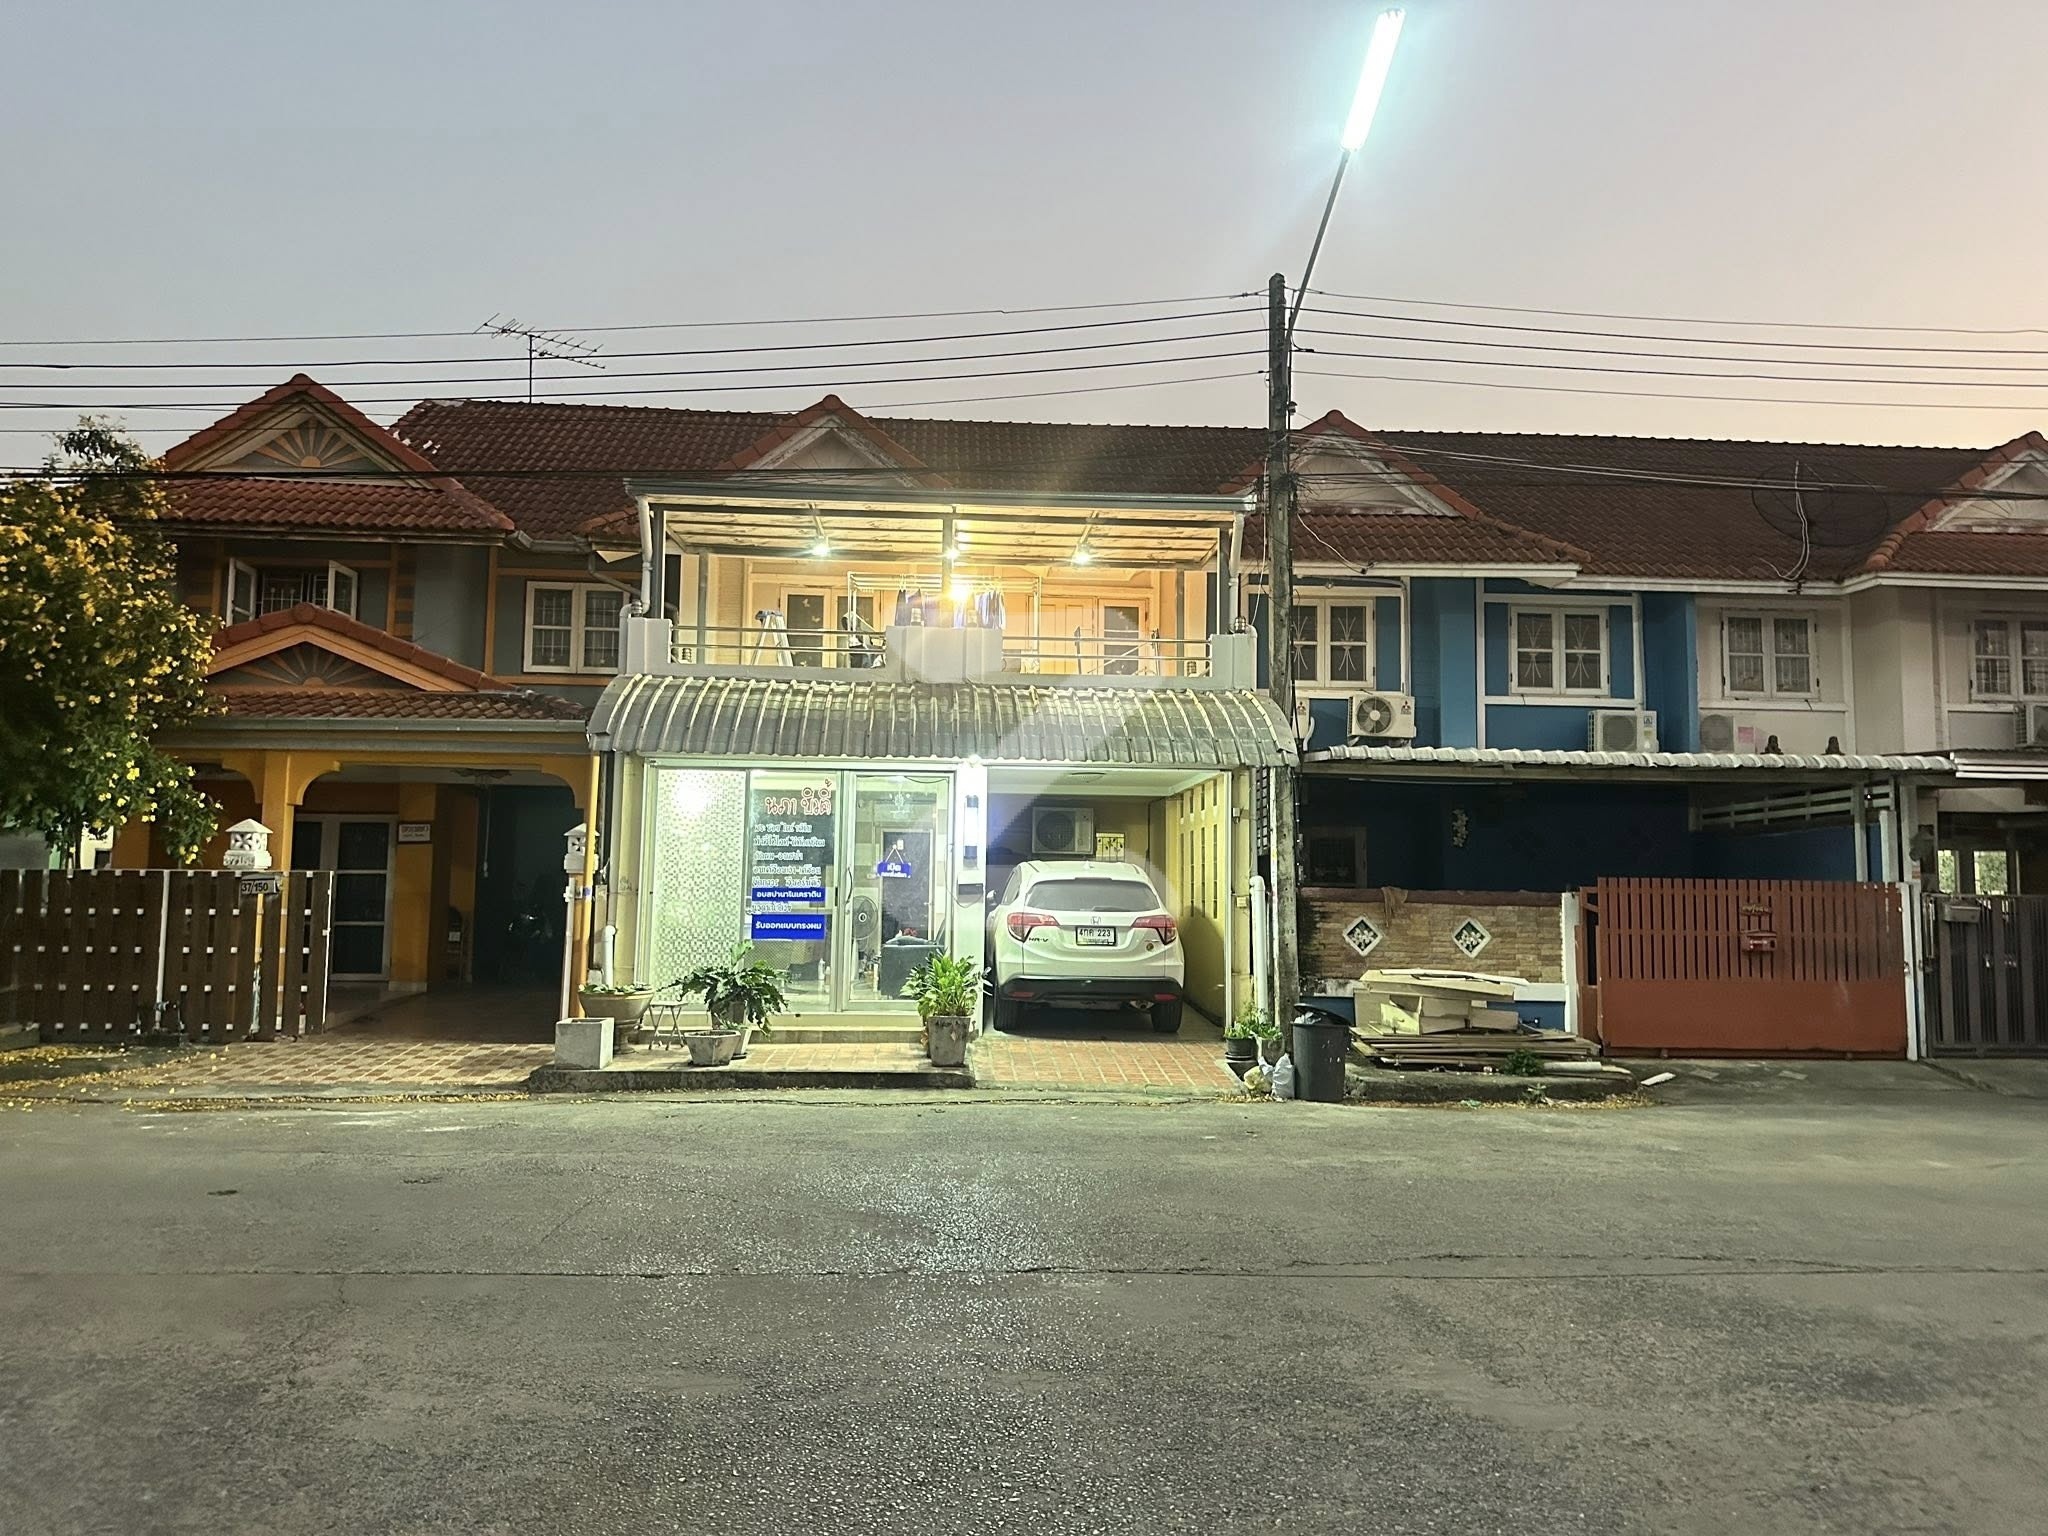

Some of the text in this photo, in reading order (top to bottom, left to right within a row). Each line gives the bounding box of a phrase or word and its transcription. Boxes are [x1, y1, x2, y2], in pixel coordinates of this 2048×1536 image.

[241, 881, 269, 893] 37/150
[755, 920, 822, 930] รับออกแบบทรงผม
[1097, 928, 1111, 937] 223
